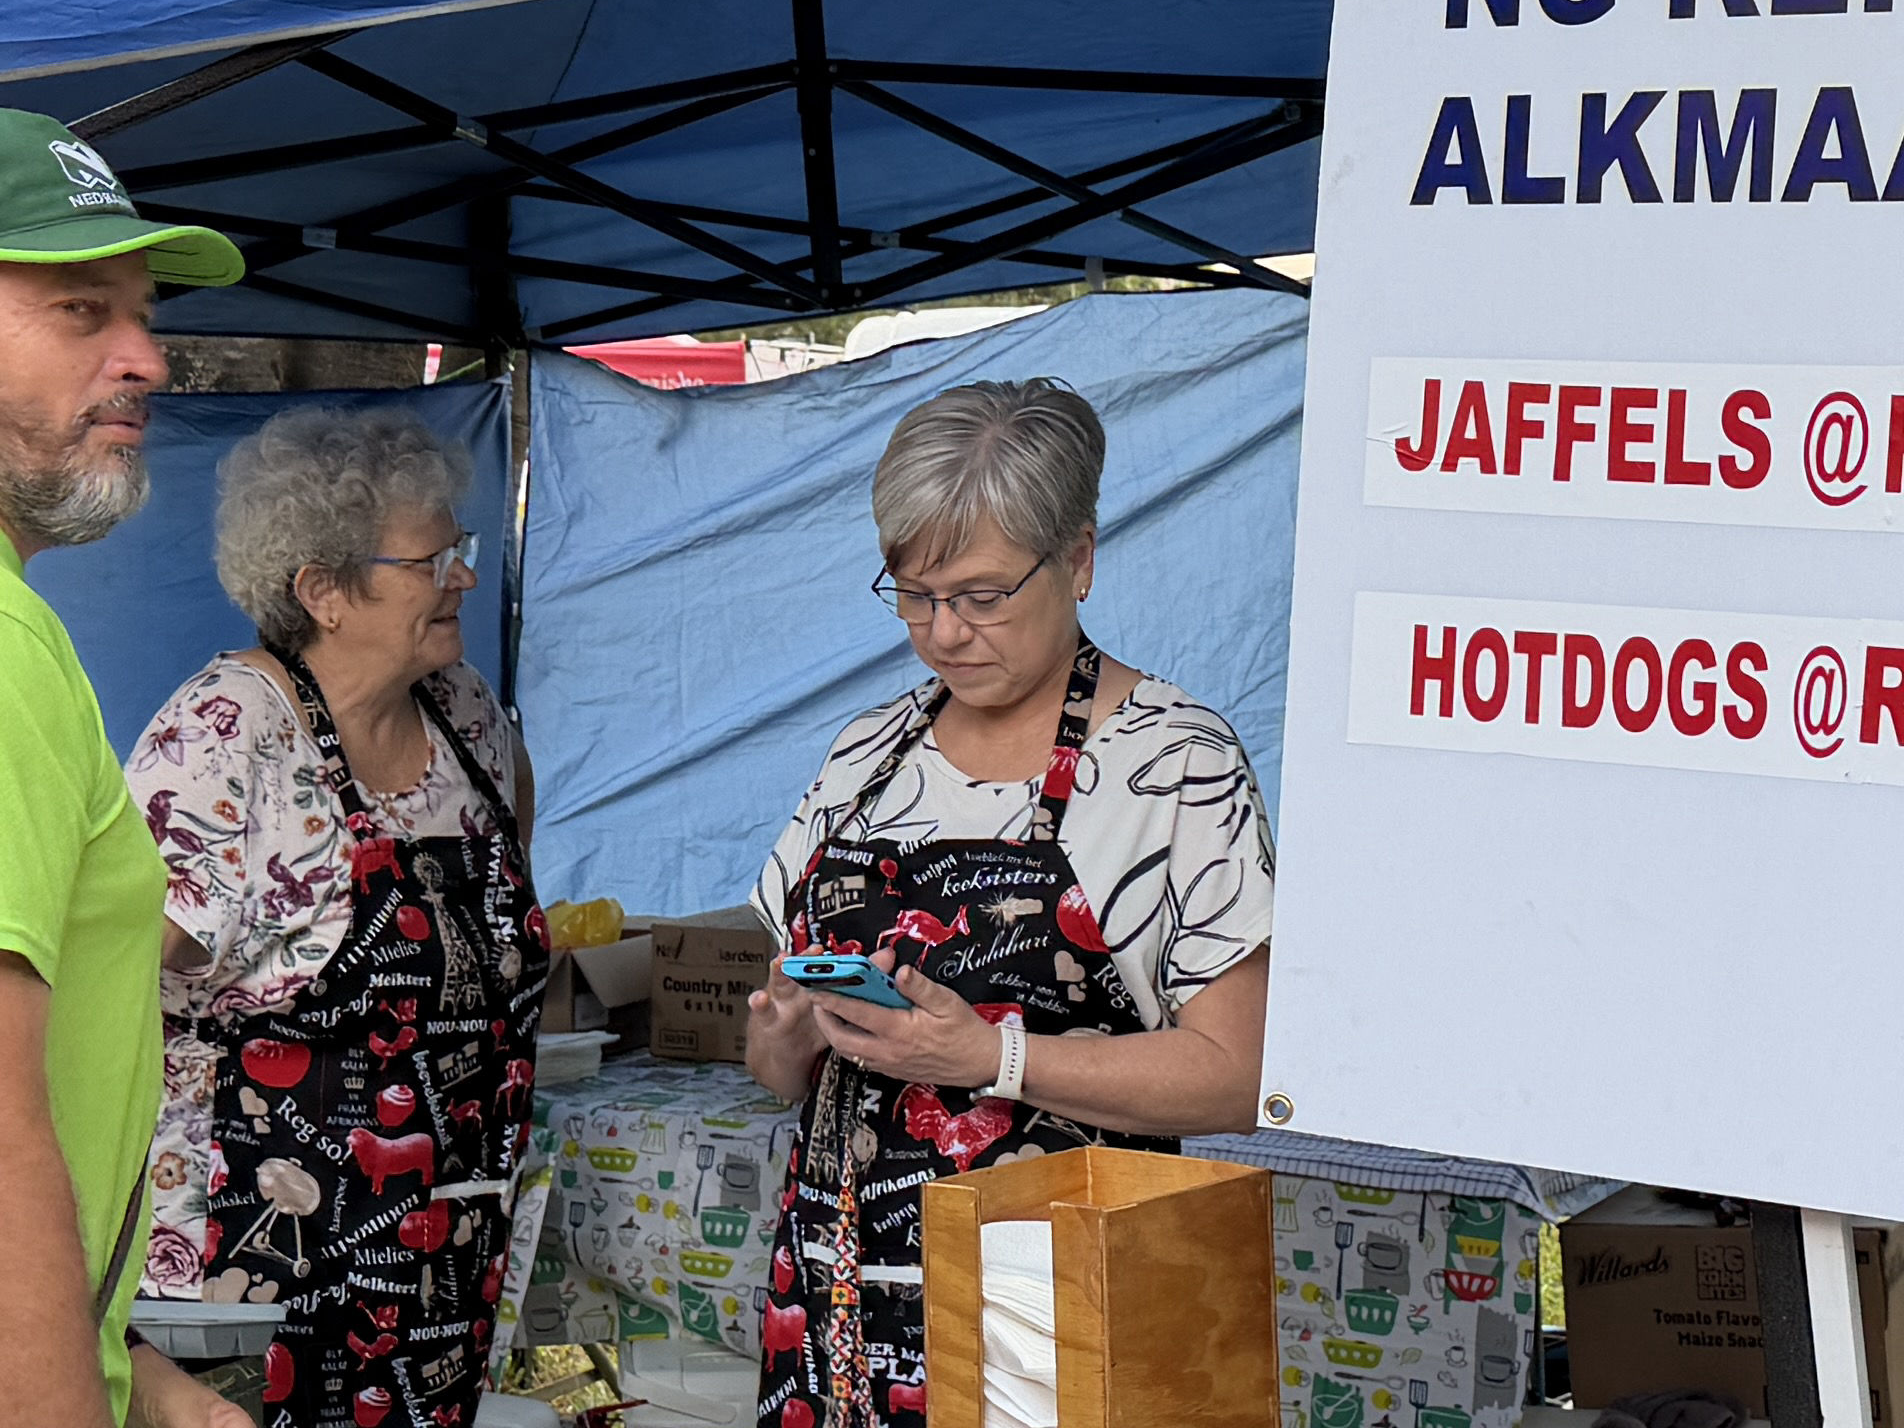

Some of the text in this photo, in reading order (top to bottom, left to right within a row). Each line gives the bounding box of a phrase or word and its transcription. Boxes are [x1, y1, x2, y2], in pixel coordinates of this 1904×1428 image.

[1394, 378, 1773, 490] JAFFELS
[1408, 623, 1769, 740] HOTDOGS
[663, 976, 723, 999] Country
[684, 999, 692, 1011] 6
[718, 1002, 734, 1017] kg
[427, 1019, 488, 1035] NOU-NOU
[276, 1095, 318, 1144] Reg
[859, 1167, 937, 1204] Afrikaans
[1578, 1246, 1670, 1287] Willards
[347, 1271, 418, 1295] Melktert
[1653, 1308, 1762, 1327] Tomato Flavo
[408, 1321, 470, 1343] NOU-NOU
[1678, 1332, 1765, 1348] Maize Snac
[869, 1357, 926, 1385] PLA
